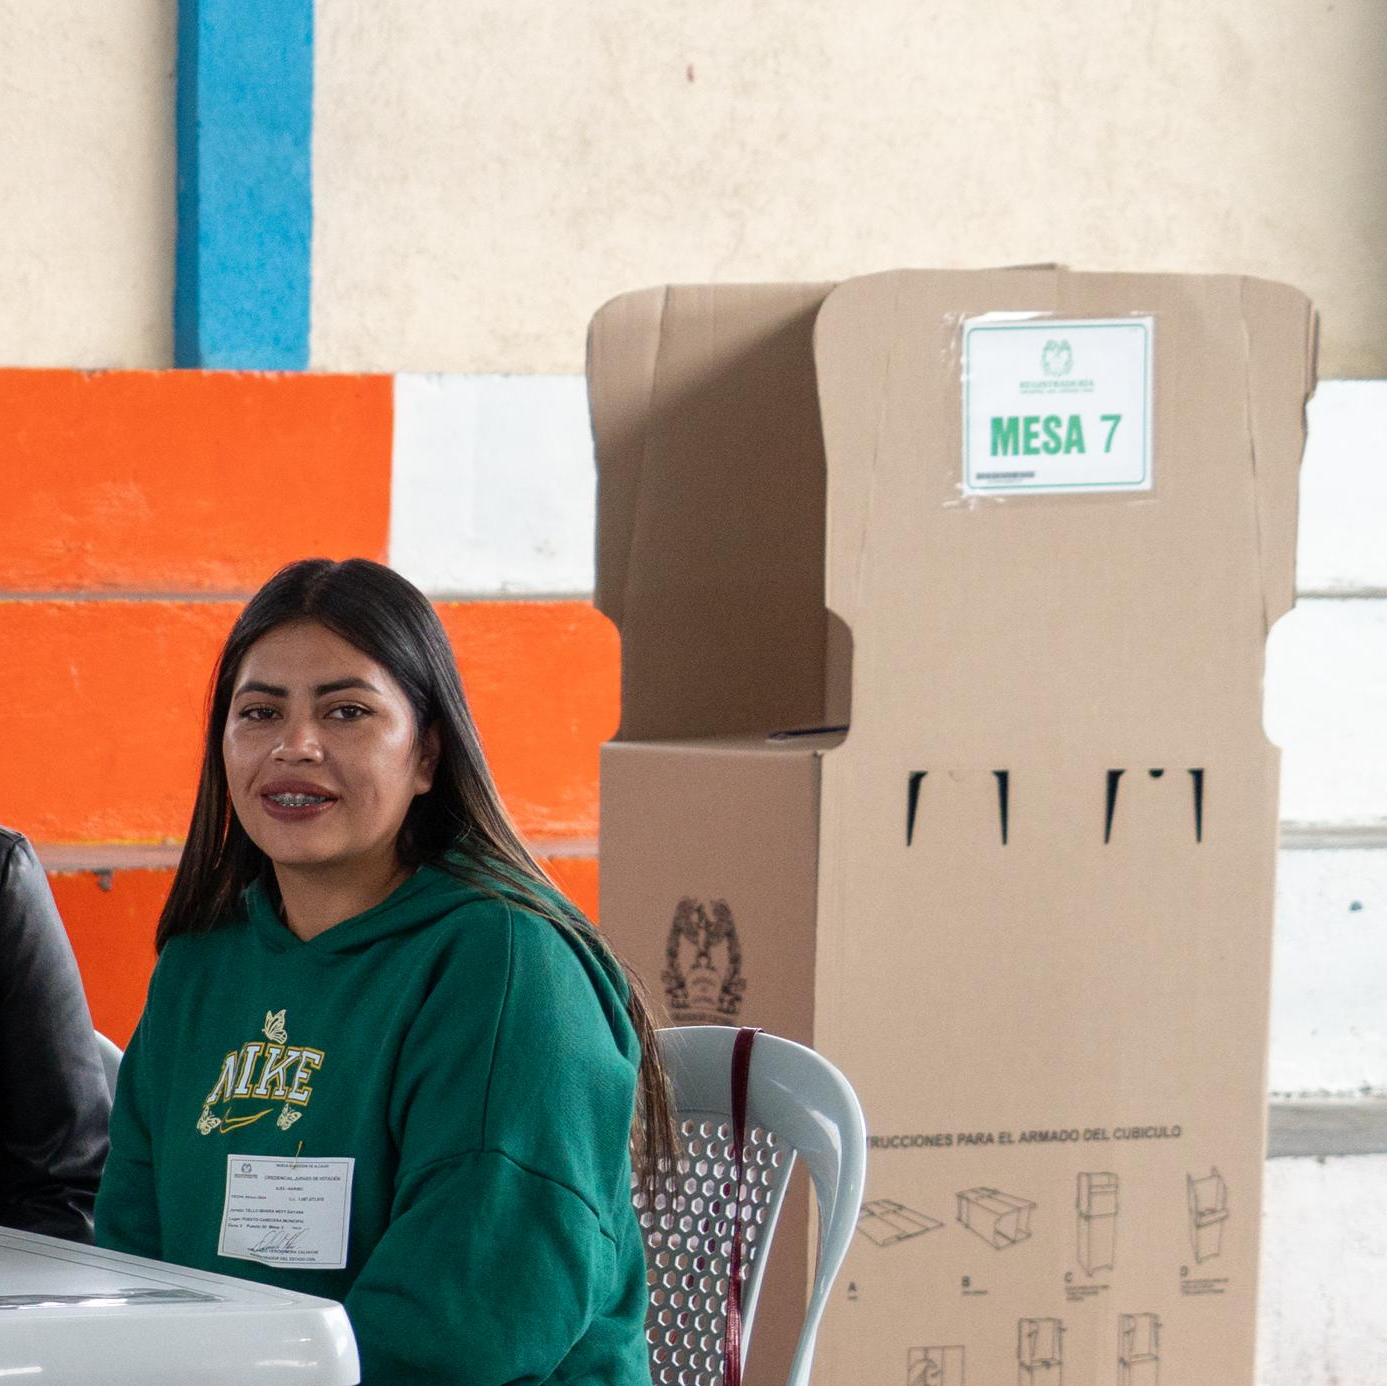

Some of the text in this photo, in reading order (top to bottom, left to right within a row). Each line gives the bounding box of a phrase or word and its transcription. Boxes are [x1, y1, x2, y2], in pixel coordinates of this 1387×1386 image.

[990, 414, 1122, 456] MESA 7
[203, 1041, 326, 1107] NIKE
[957, 1132, 994, 1145] PARA
[998, 1131, 1015, 1144] EL
[1019, 1129, 1080, 1143] ARMADO
[1083, 1127, 1110, 1141] DEL
[1113, 1125, 1181, 1140] CUBICULO
[1064, 1271, 1073, 1283] C
[1180, 1265, 1188, 1277] D
[848, 1281, 857, 1292] A
